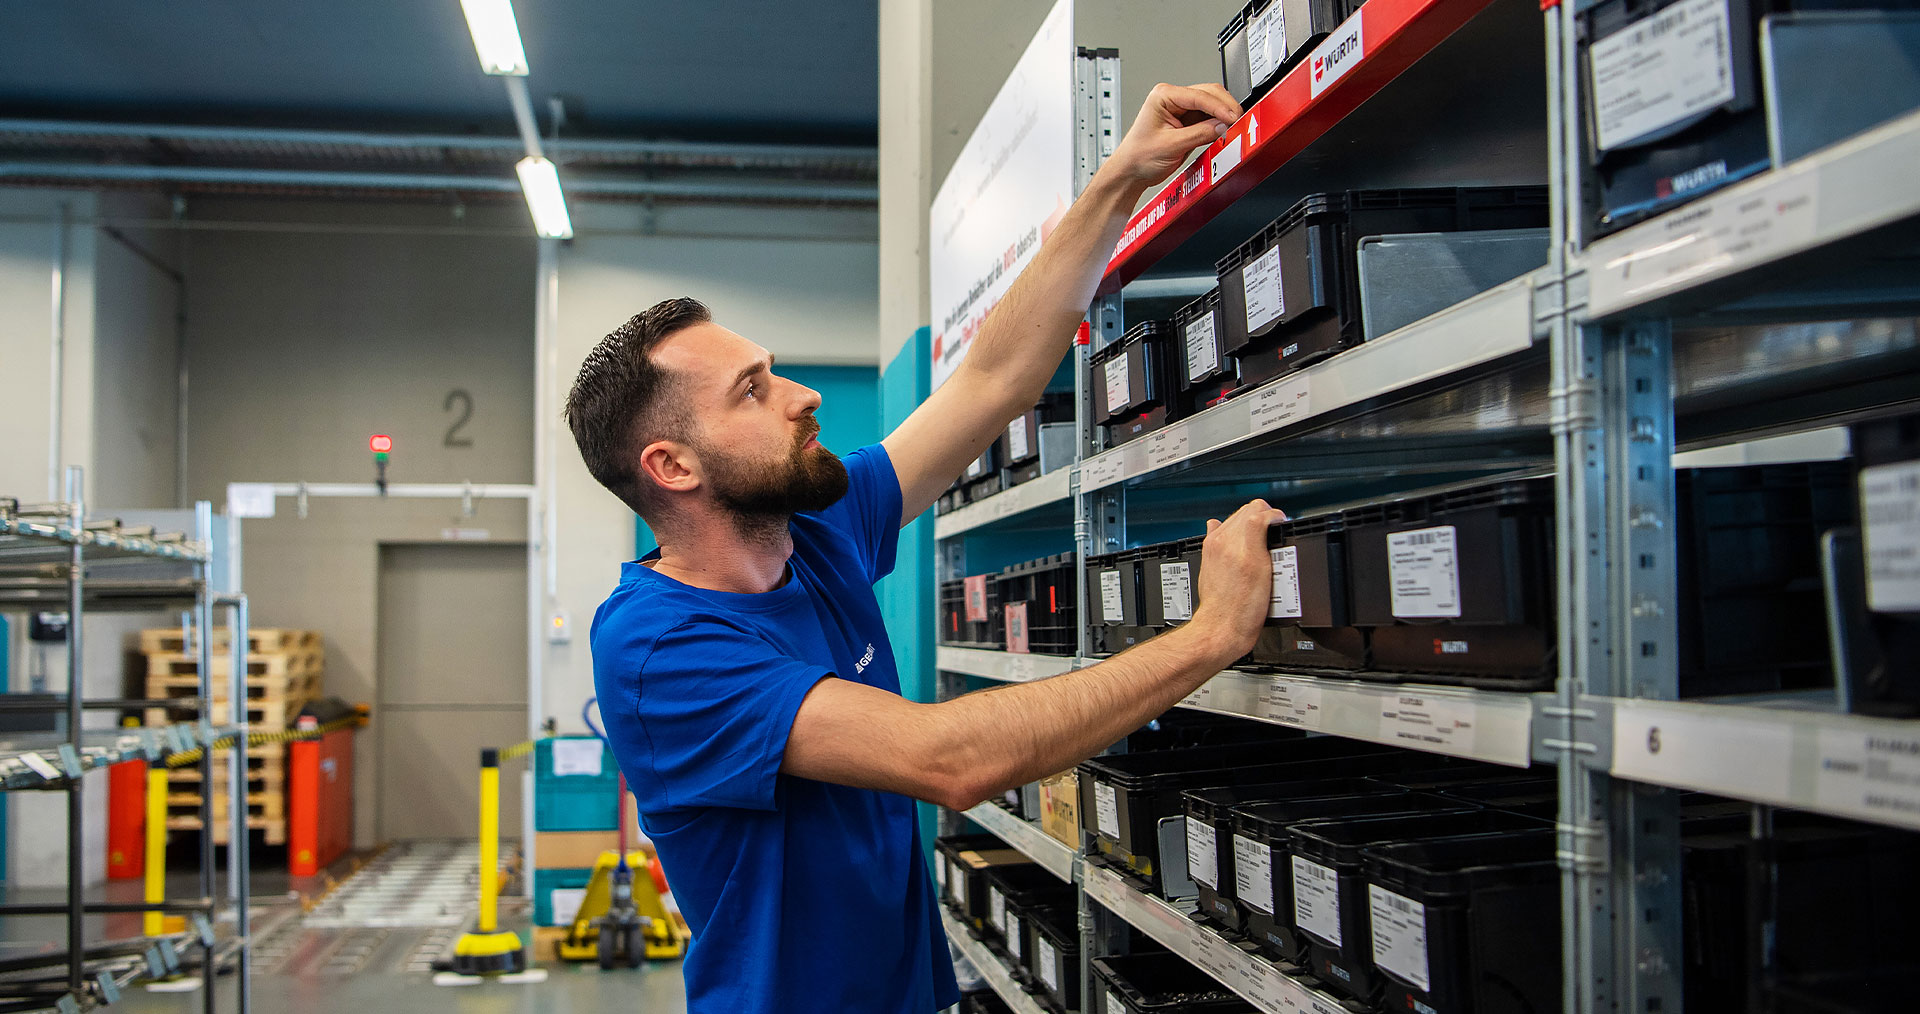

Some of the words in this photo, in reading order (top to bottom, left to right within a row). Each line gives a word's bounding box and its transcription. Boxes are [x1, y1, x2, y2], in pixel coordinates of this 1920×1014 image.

[1325, 31, 1358, 71] WÜRTH
[1182, 164, 1204, 198] STELLEN!
[1212, 161, 1218, 178] 2
[443, 388, 474, 448] 2
[1646, 726, 1662, 755] 6
